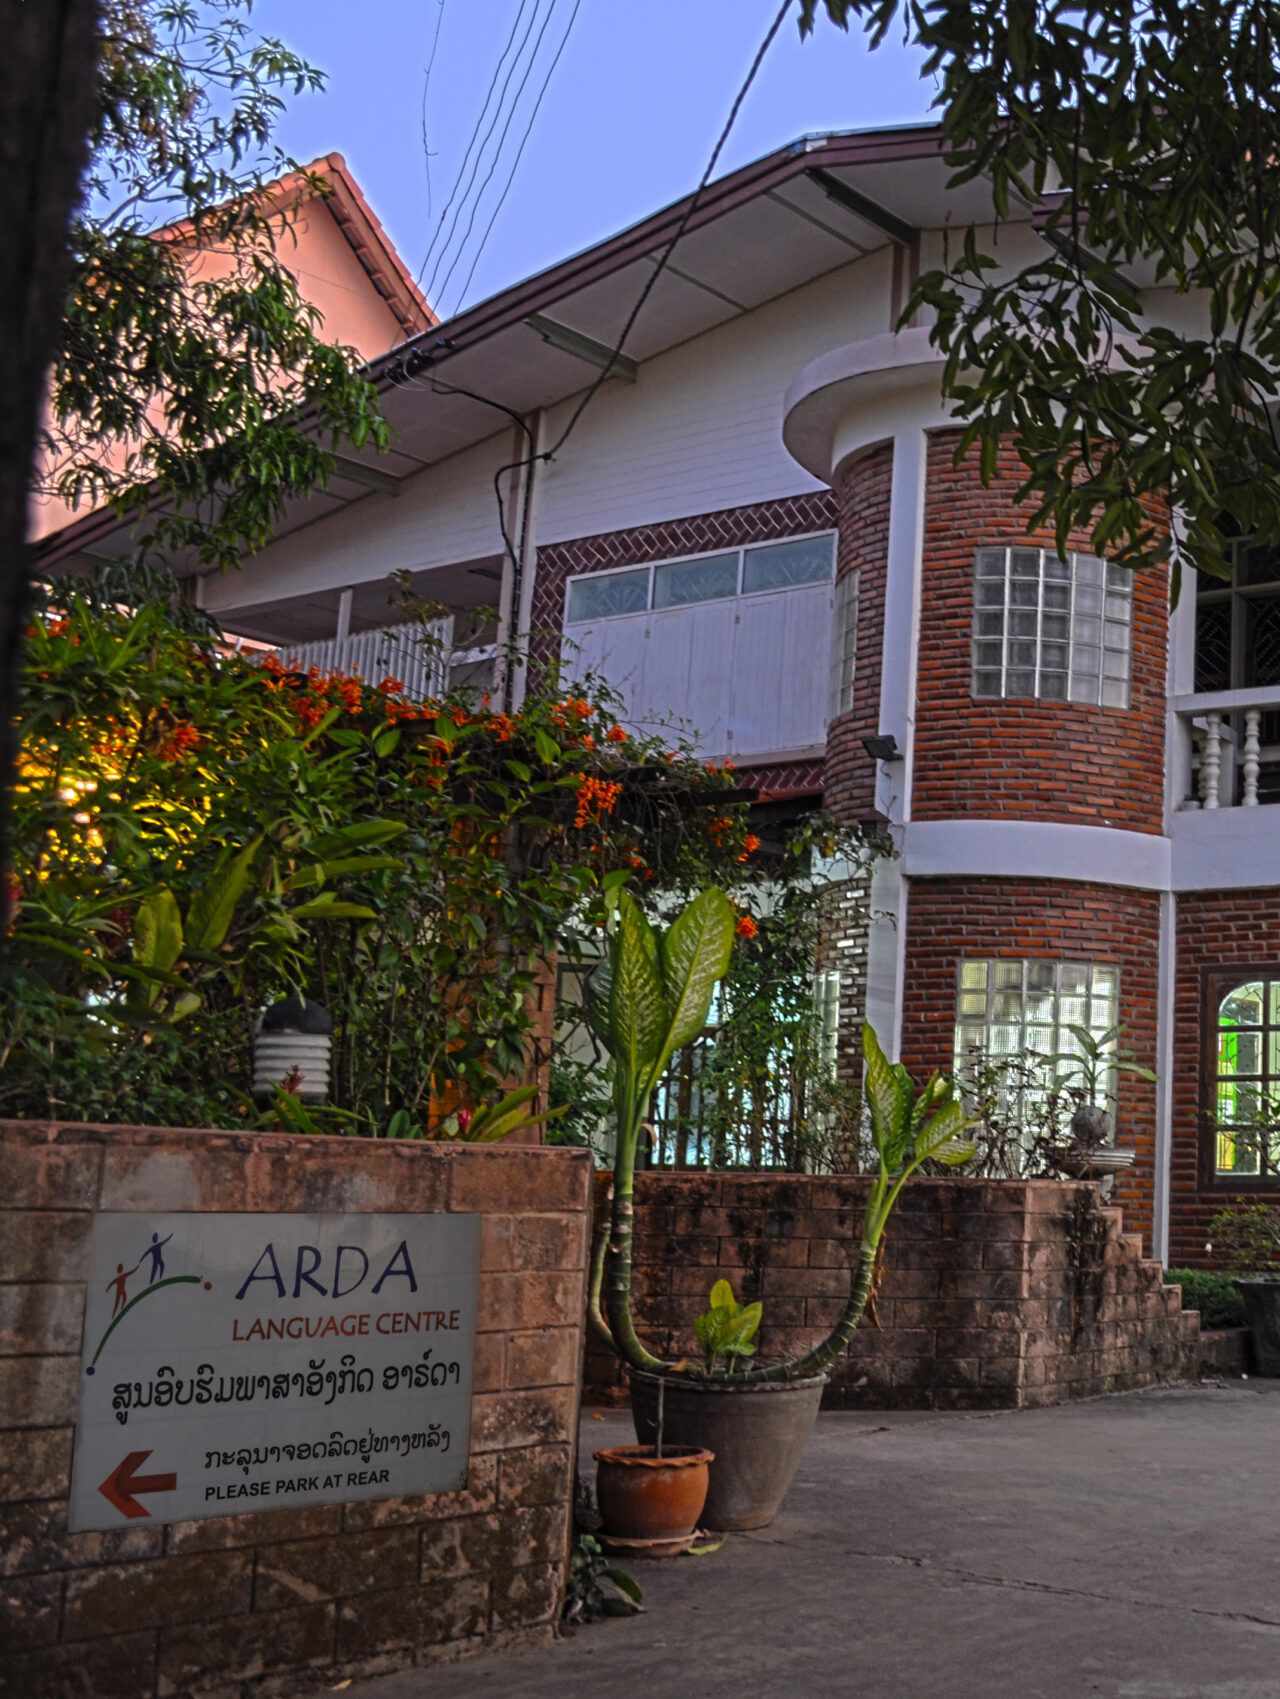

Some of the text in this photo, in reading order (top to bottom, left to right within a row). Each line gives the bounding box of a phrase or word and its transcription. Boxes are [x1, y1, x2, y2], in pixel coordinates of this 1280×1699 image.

[234, 1240, 419, 1300] ARDA
[232, 1310, 461, 1341] LANGUAGE CENTRE
[205, 1469, 390, 1501] PLEASE PARK AT REAR
